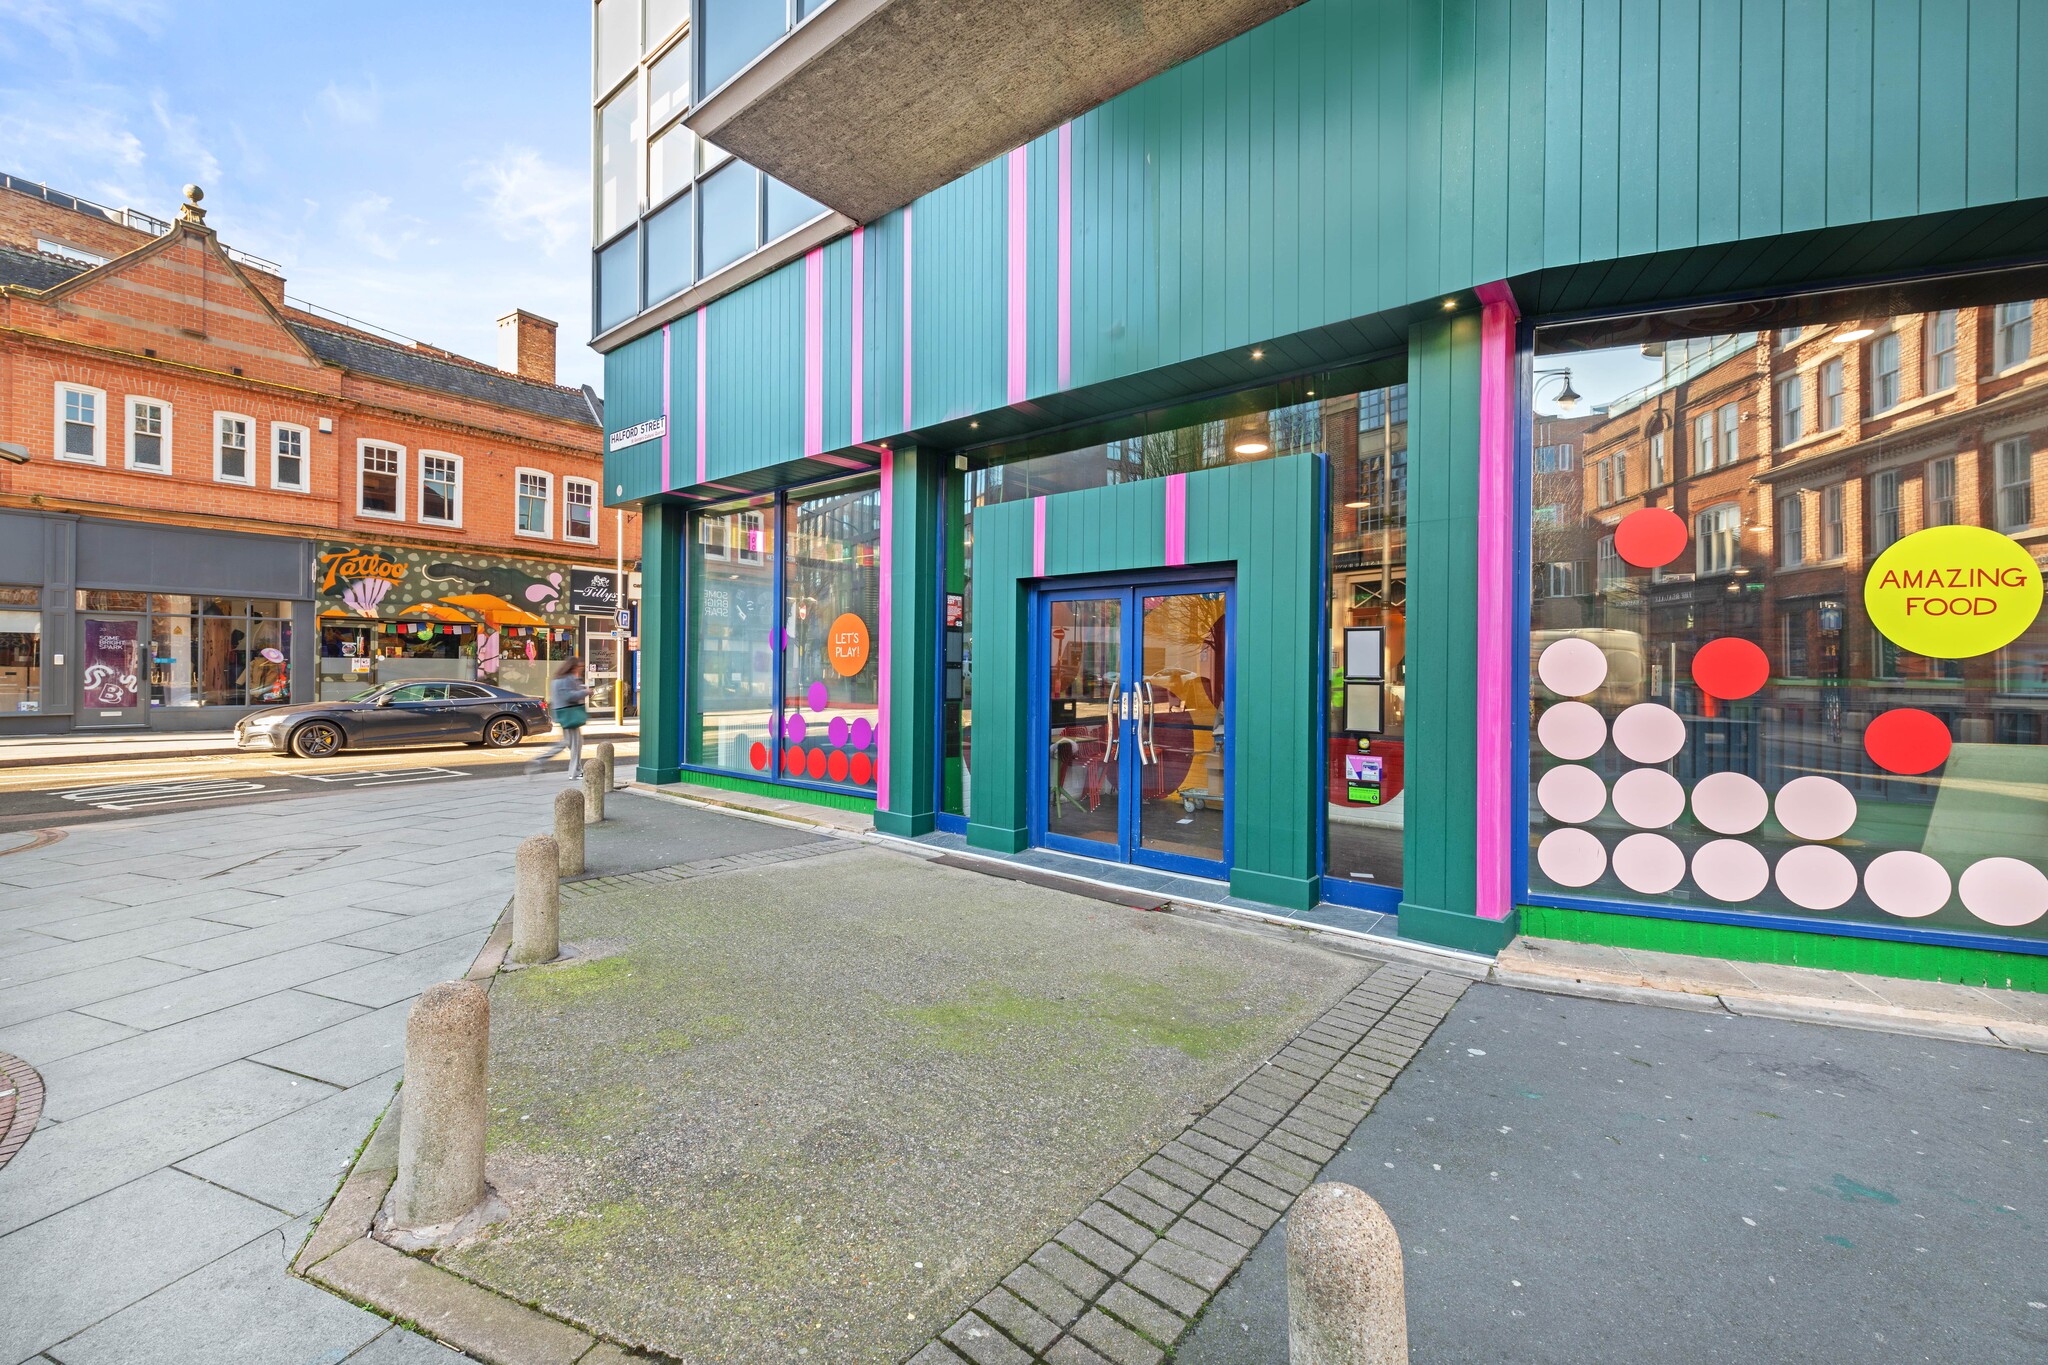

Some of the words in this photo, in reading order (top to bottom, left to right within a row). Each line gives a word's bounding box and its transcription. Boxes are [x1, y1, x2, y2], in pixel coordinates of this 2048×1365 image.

[611, 427, 638, 444] HALFORD
[641, 418, 665, 434] STREET
[321, 549, 409, 593] Tattoo
[1879, 567, 2028, 590] AMAZING
[582, 586, 617, 603] Tillys
[1906, 597, 1998, 616] FOOD
[622, 613, 628, 625] P
[836, 632, 859, 645] LET'S
[836, 646, 860, 658] PLAY!
